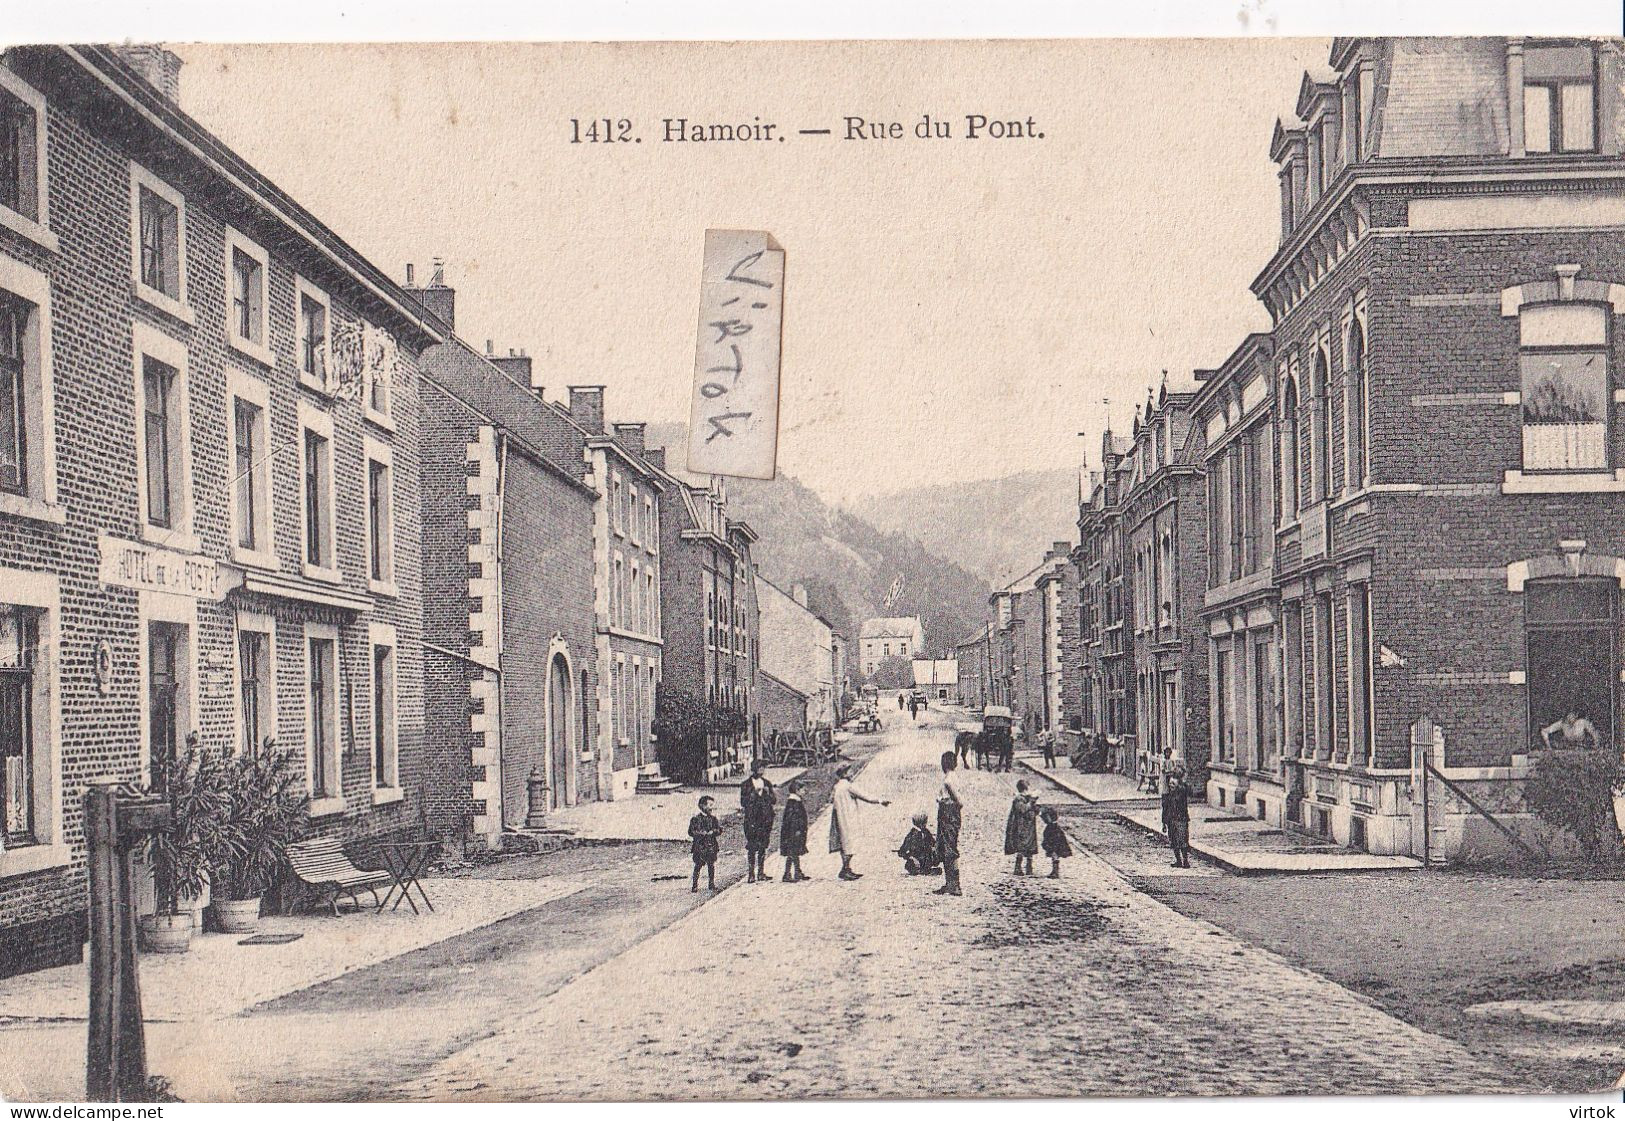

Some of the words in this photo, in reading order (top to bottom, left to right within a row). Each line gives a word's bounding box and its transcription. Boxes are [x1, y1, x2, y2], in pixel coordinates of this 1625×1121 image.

[569, 118, 643, 144] 1412.
[662, 115, 785, 143] Hamoir.
[843, 115, 905, 141] Rue
[915, 115, 953, 140] du
[965, 115, 1047, 140] Pont.
[118, 547, 154, 584] HOTEL
[184, 560, 220, 594] POSTE
